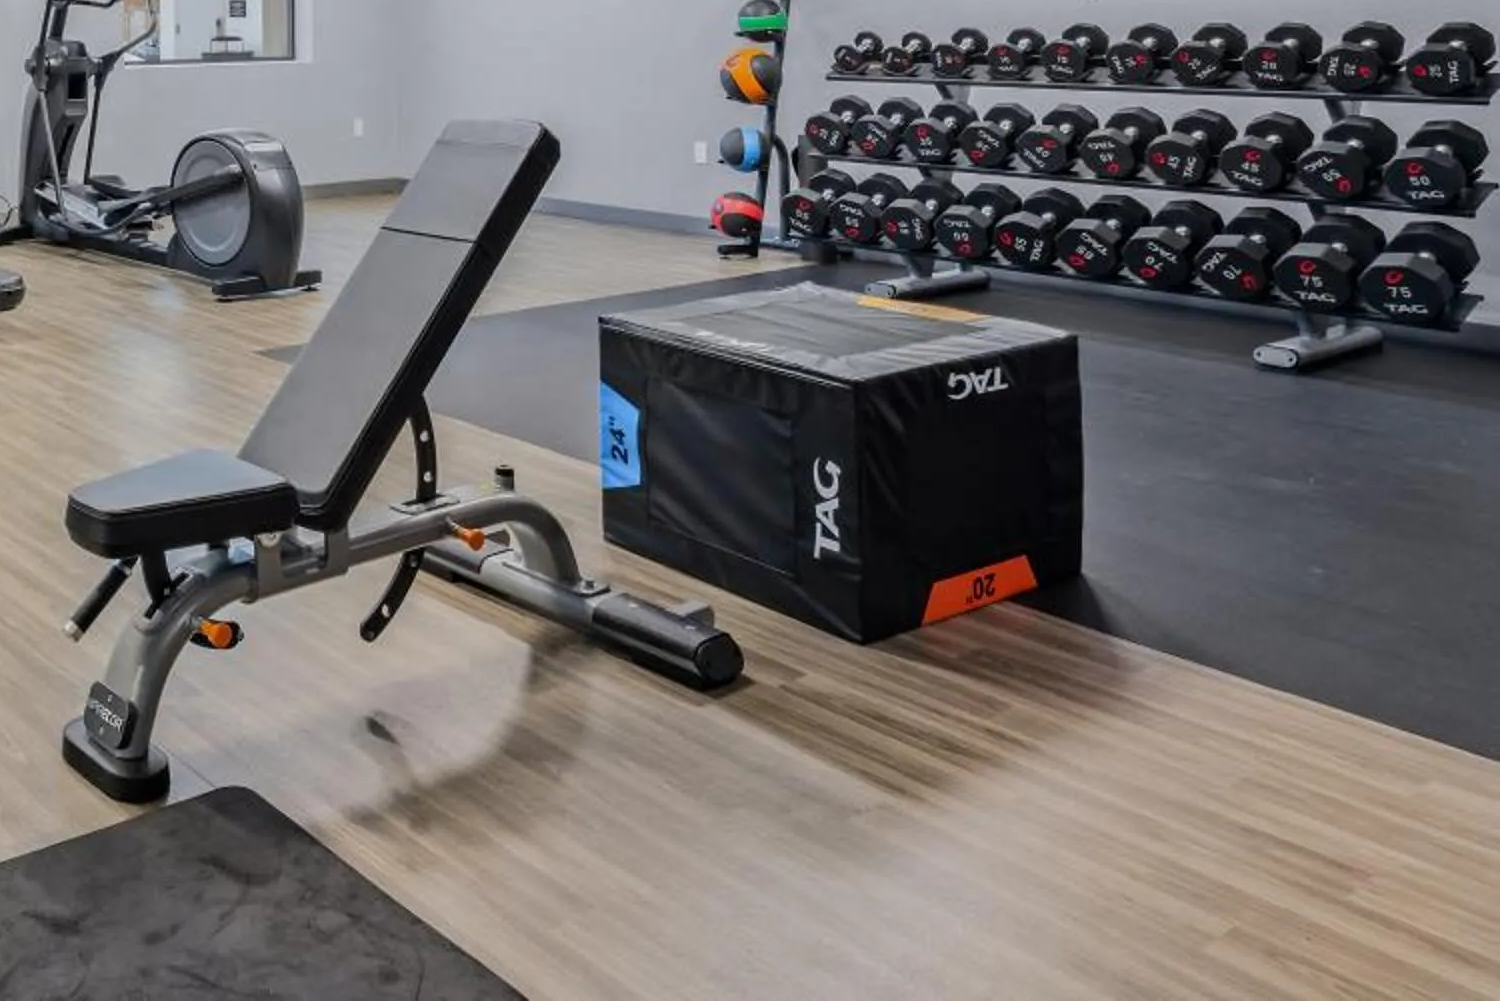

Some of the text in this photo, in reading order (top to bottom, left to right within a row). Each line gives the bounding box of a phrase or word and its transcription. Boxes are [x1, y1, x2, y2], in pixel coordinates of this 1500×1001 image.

[1327, 55, 1340, 77] TAG
[1447, 60, 1460, 83] TAG
[1182, 156, 1197, 179] TAG
[1303, 155, 1334, 173] TAG
[1231, 170, 1263, 187] TAG
[1409, 175, 1431, 186] 50
[1408, 189, 1445, 200] TAG
[1029, 238, 1045, 262] TAG
[1079, 232, 1109, 256] TAG
[1146, 242, 1179, 265] TAG
[1202, 252, 1228, 273] TAG
[1300, 275, 1324, 288] 75
[1293, 290, 1337, 304] TAG
[1387, 286, 1413, 299] 75
[1383, 302, 1430, 315] TAG
[948, 366, 1009, 400] TAG
[813, 457, 841, 559] TAG
